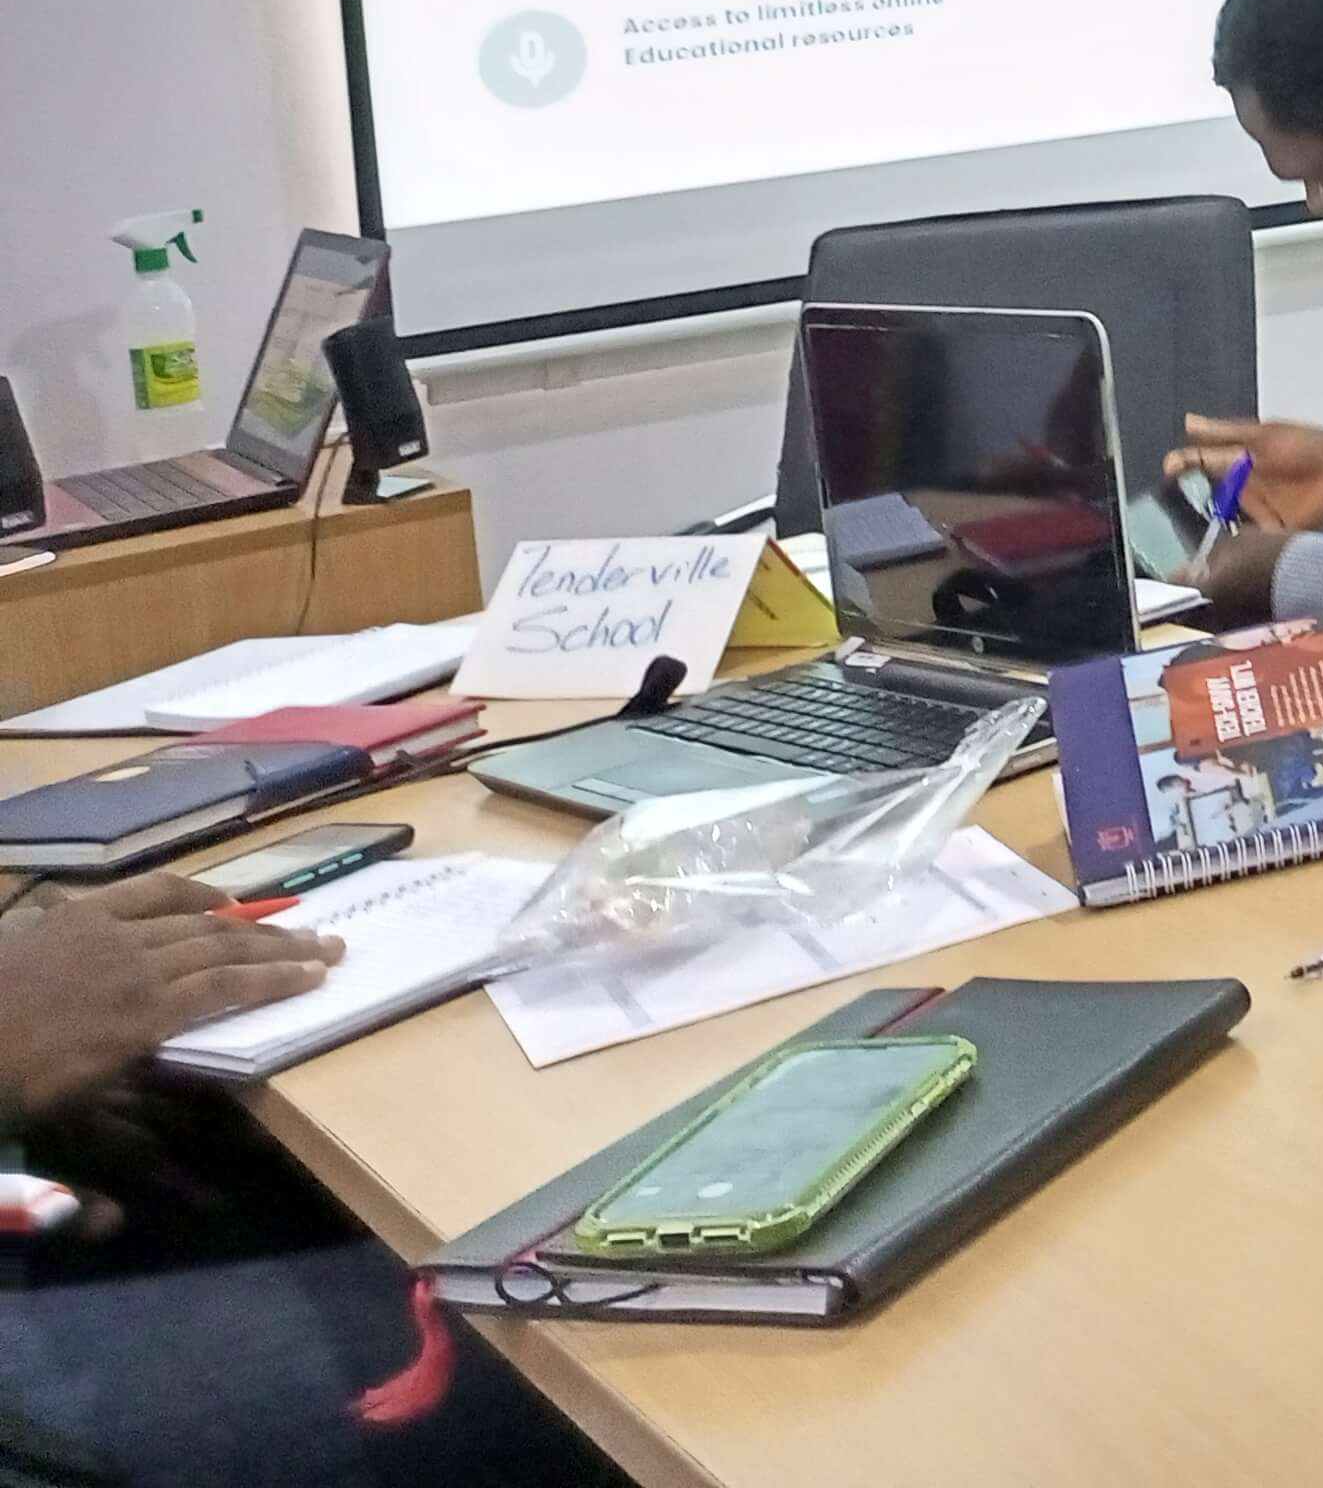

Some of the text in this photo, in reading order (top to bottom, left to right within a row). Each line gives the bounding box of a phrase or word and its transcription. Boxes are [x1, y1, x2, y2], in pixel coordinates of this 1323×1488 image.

[623, 14, 717, 35] Access
[724, 8, 750, 25] to
[624, 21, 915, 66] Educational resources
[505, 599, 673, 654] School
